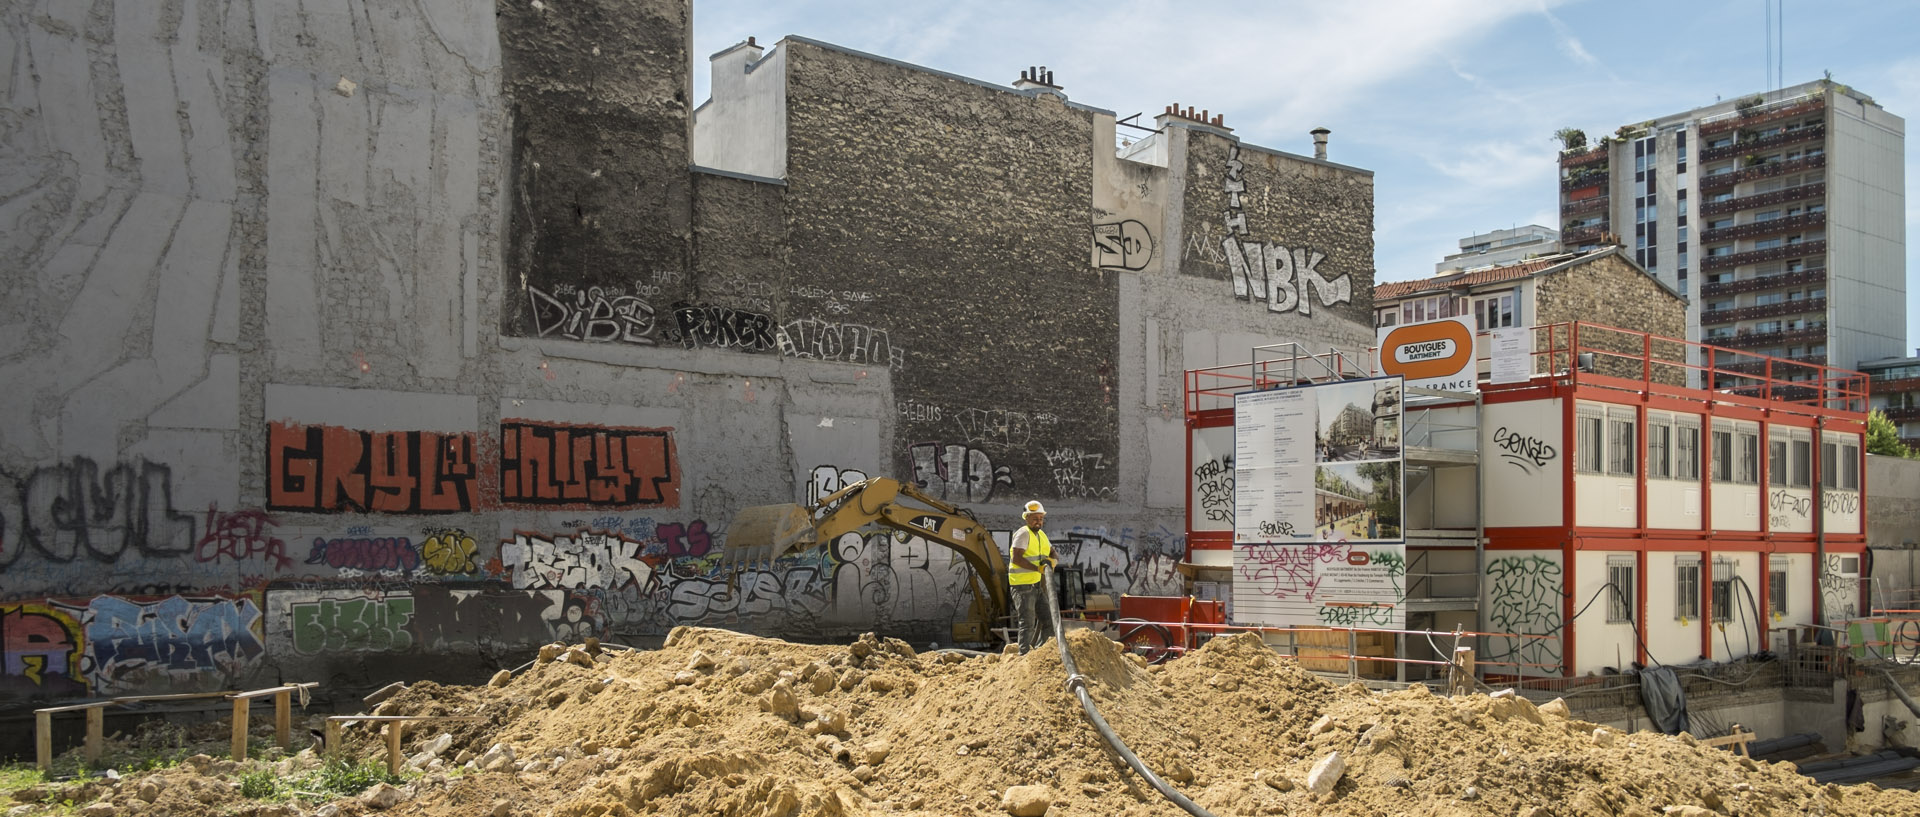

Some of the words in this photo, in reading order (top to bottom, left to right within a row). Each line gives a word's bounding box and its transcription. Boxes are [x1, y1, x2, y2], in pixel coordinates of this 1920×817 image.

[1221, 233, 1353, 318] NBK
[672, 303, 778, 352] POKER
[1404, 341, 1446, 355] BOUYGUES
[923, 516, 937, 532] CAT
